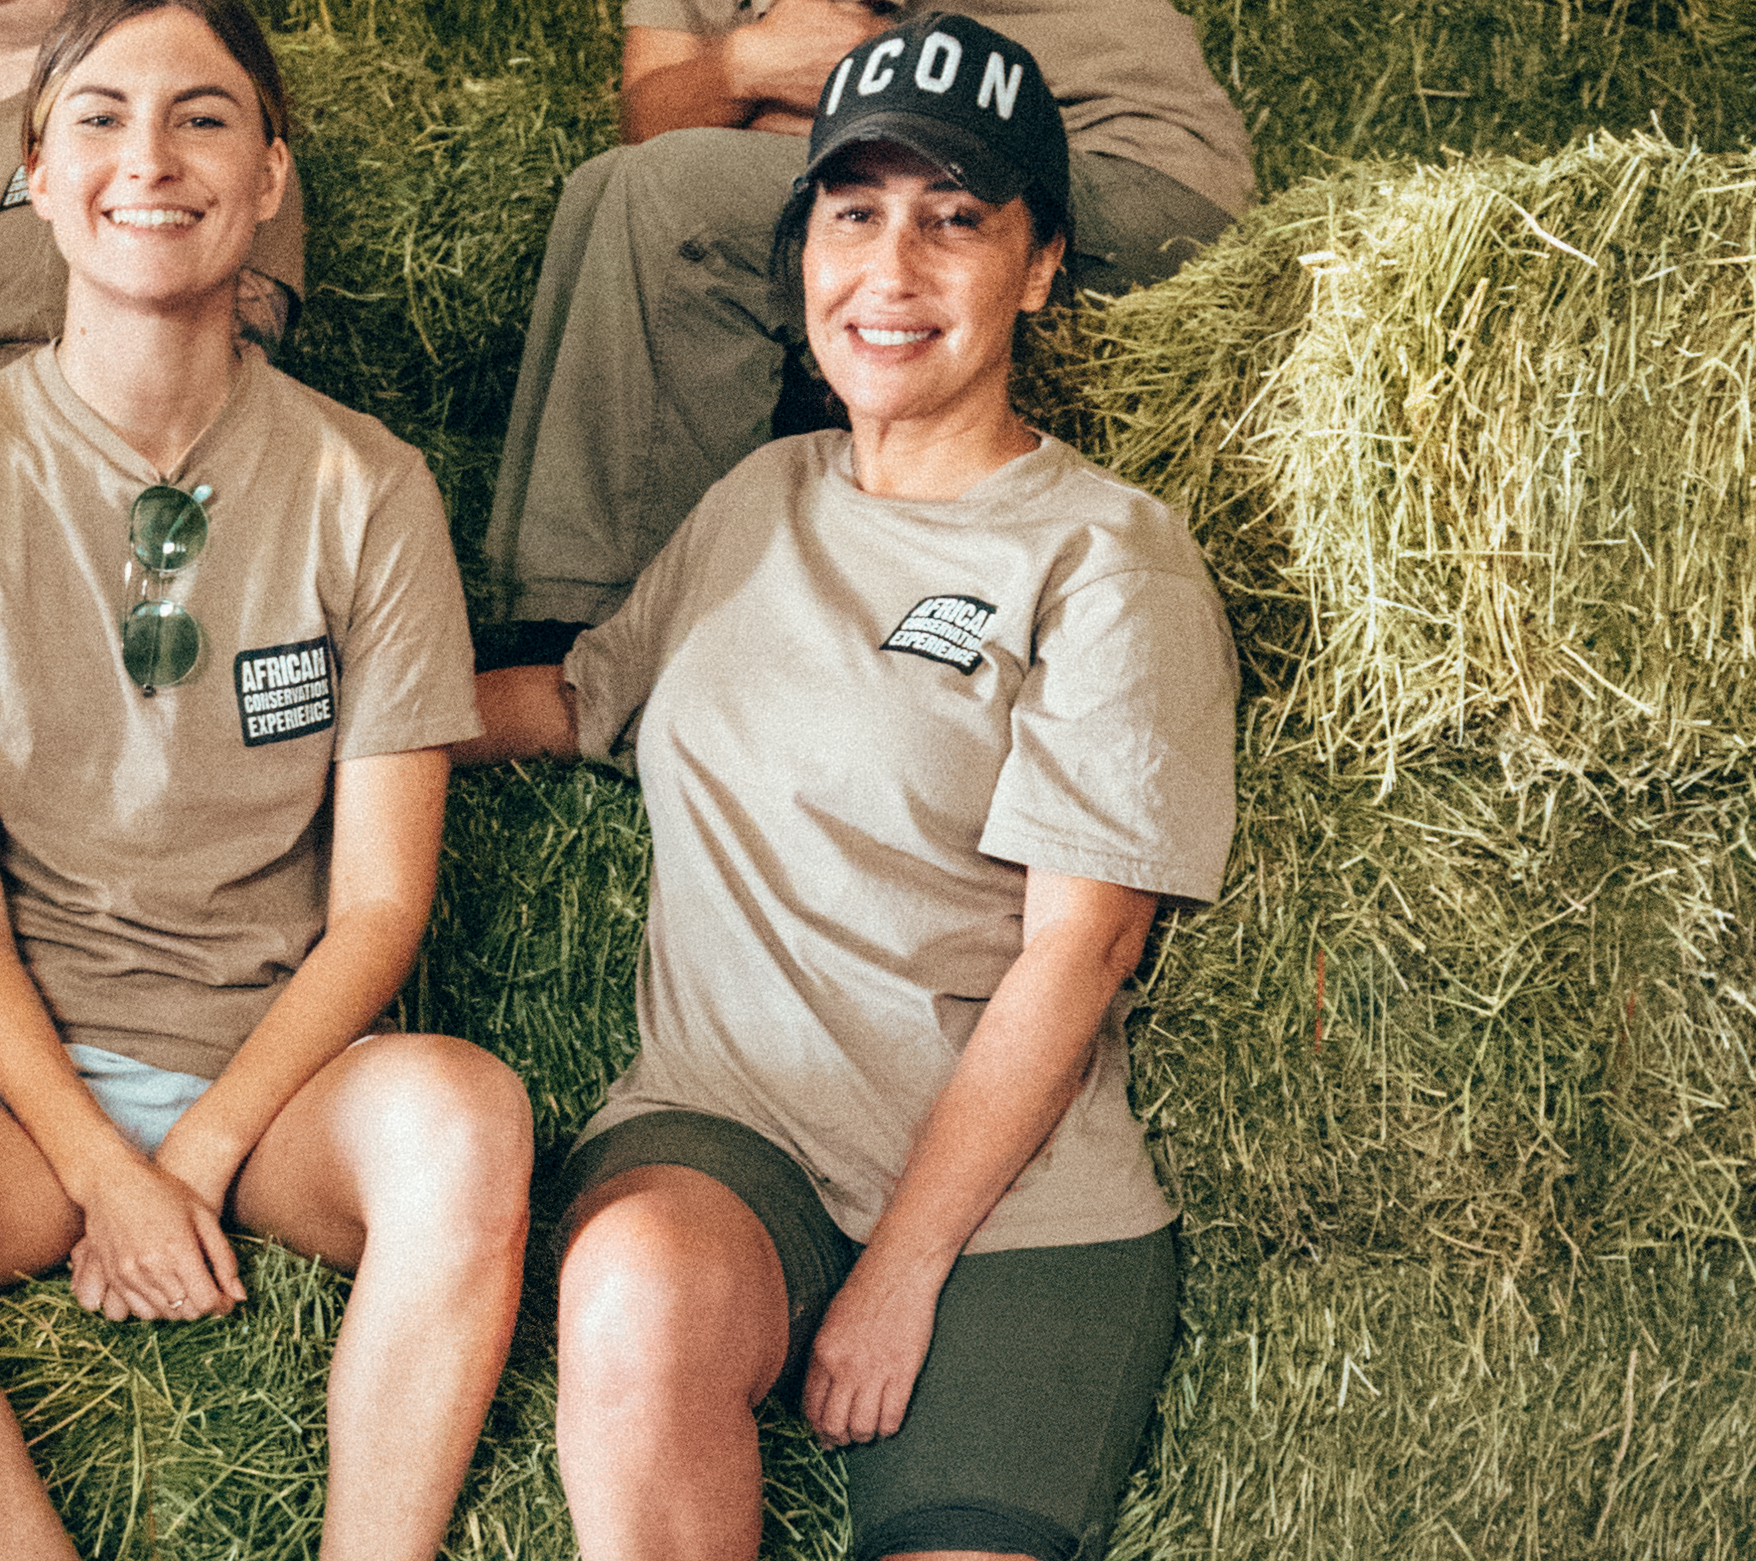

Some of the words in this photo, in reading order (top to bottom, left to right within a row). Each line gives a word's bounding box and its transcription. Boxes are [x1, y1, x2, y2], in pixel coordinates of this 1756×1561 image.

[826, 31, 1023, 120] ICON
[888, 630, 979, 667] EXPERIENCE
[242, 647, 326, 693] AFRICAN
[244, 678, 329, 714] CONSERVATION
[247, 699, 331, 738] EXPERIENCE
